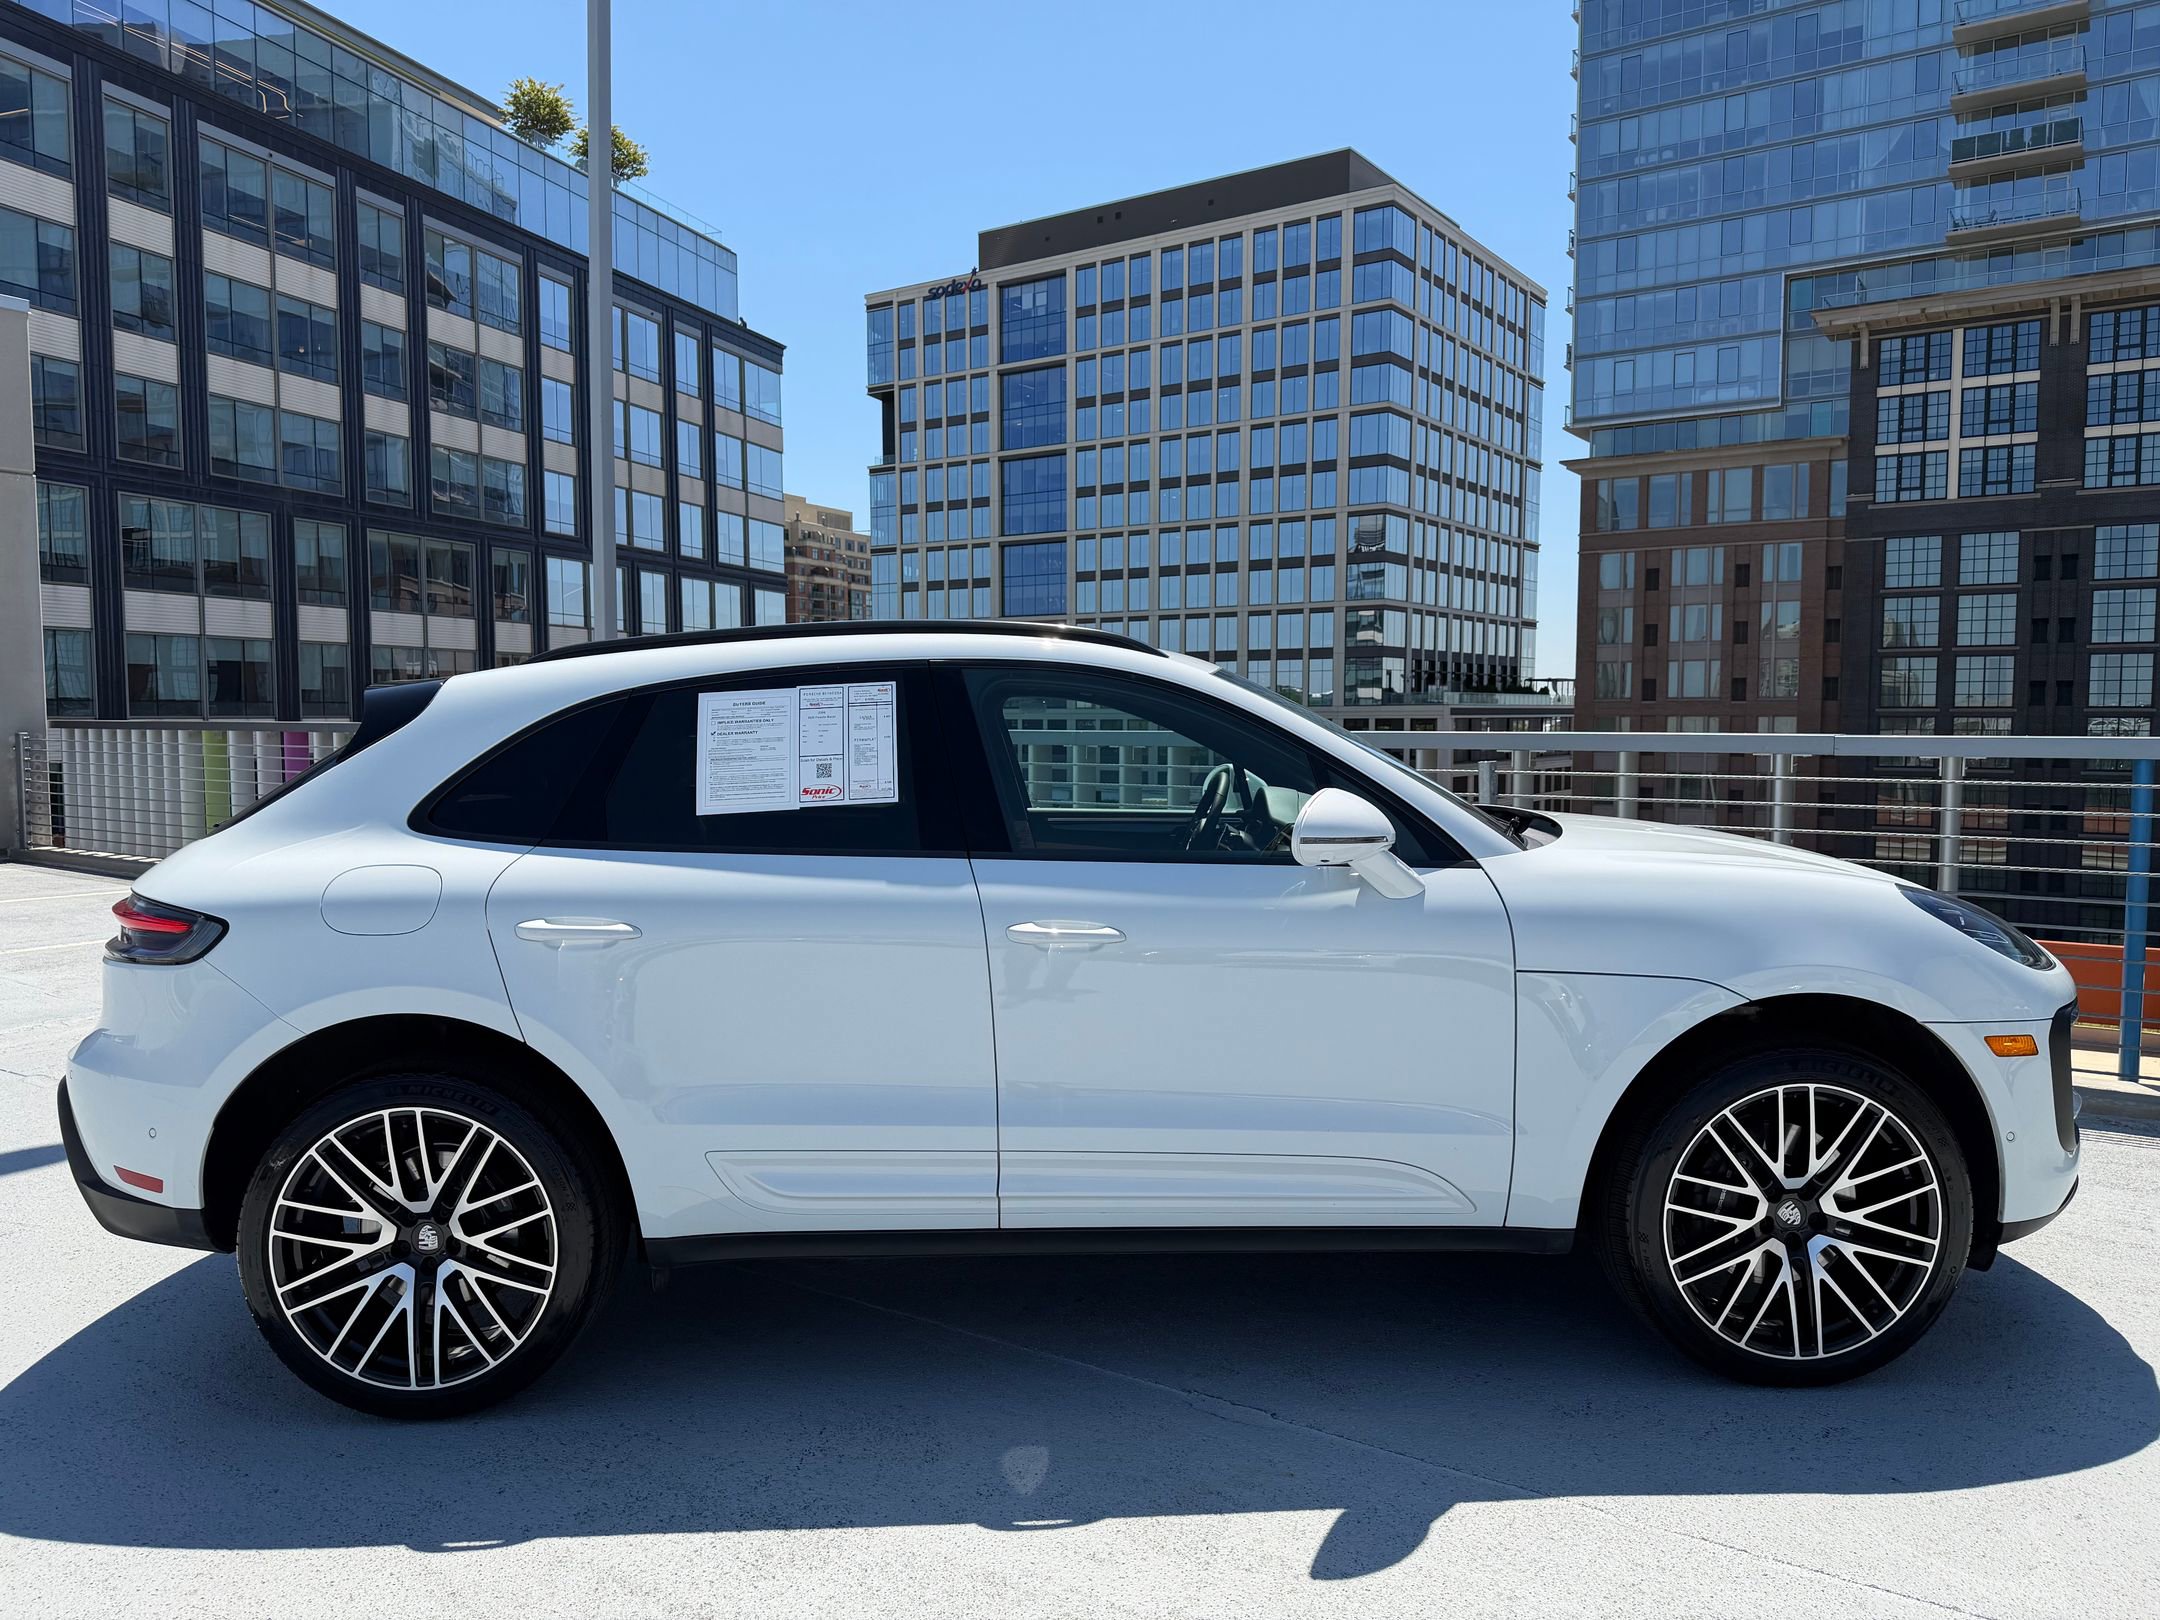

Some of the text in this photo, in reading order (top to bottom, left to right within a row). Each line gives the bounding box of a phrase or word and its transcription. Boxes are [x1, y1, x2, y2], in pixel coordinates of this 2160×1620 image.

[928, 270, 982, 298] sodexo
[801, 786, 836, 796] Sonic
[407, 1085, 496, 1113] MICHELIN
